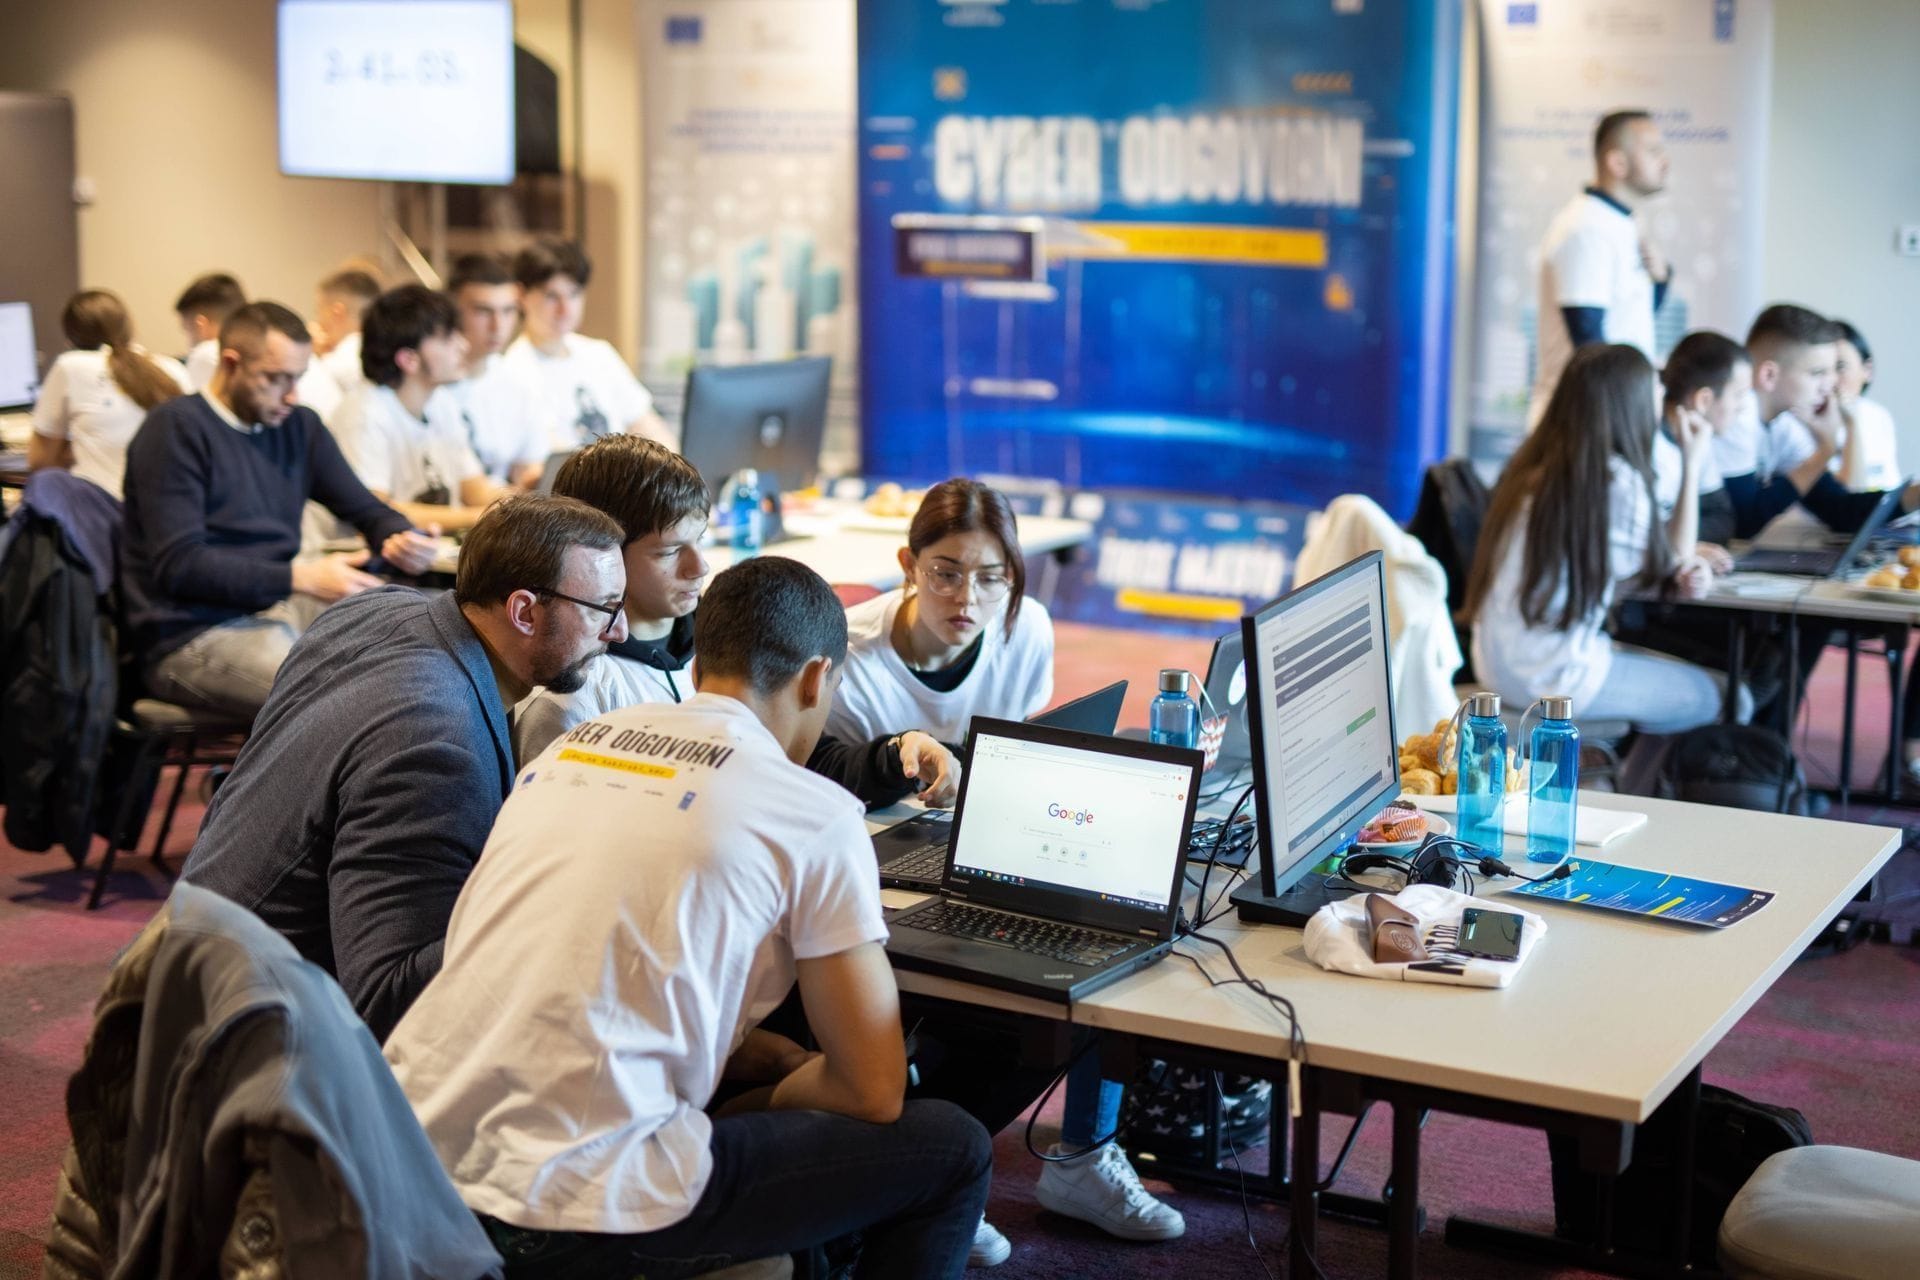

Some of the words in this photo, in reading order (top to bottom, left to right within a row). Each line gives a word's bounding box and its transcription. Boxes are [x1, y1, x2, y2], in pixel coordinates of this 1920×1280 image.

[935, 115, 1101, 210] CYBER
[609, 729, 734, 769] ODGOVORNI
[1048, 803, 1094, 825] Google
